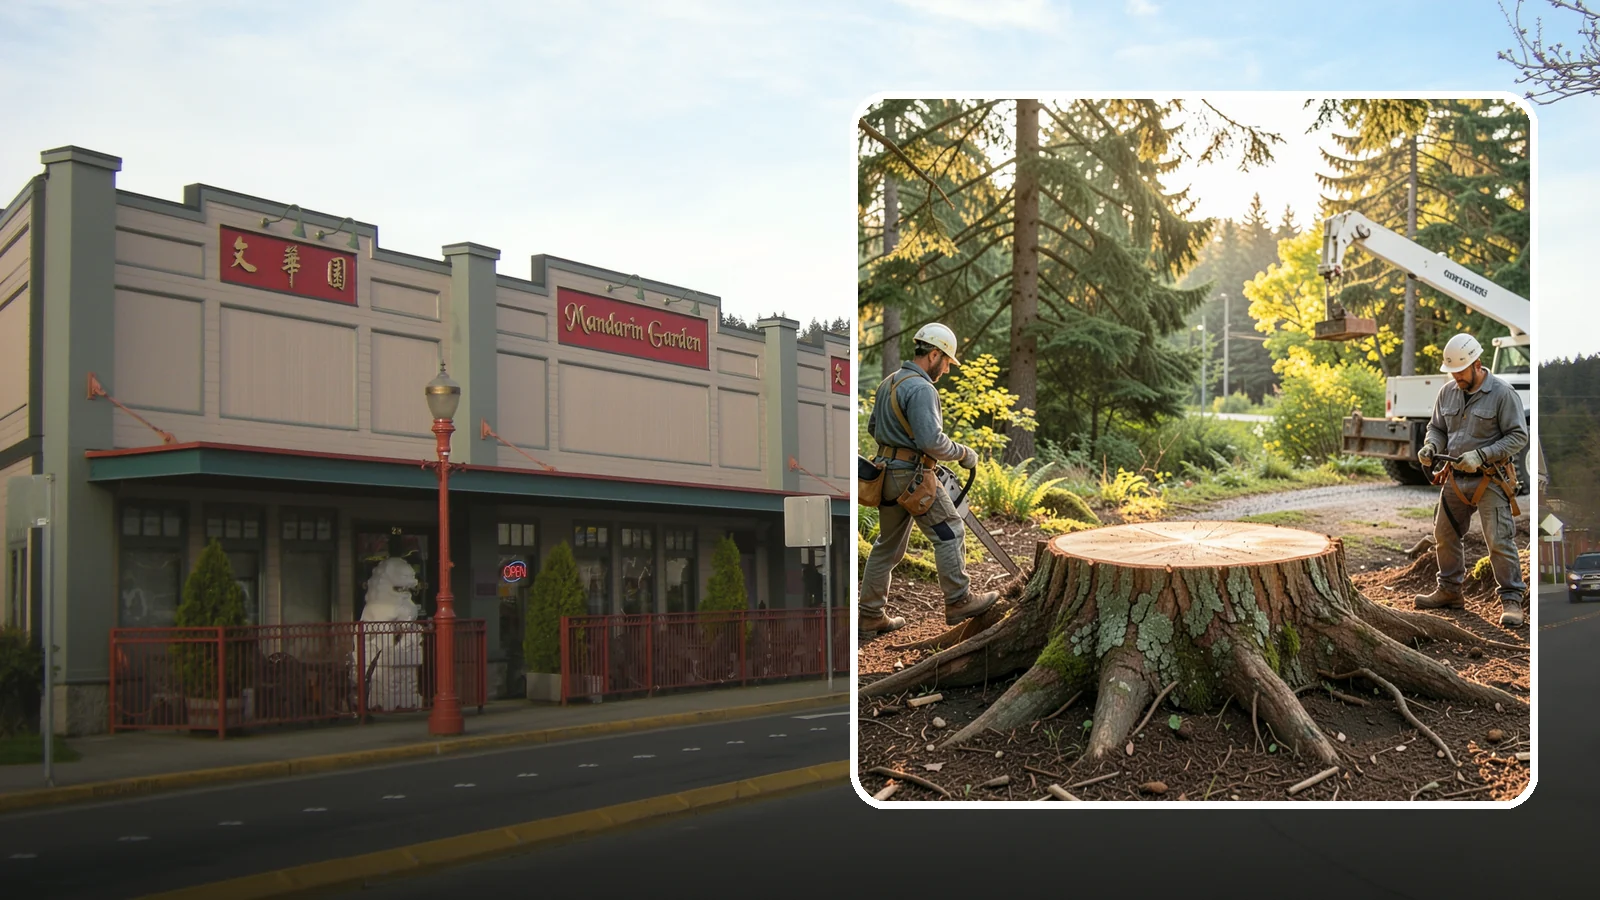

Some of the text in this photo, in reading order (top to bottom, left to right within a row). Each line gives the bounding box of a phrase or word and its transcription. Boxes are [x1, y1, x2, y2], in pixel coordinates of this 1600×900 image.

[564, 302, 701, 351] Mandarin Garden
[503, 565, 526, 578] OPEN
